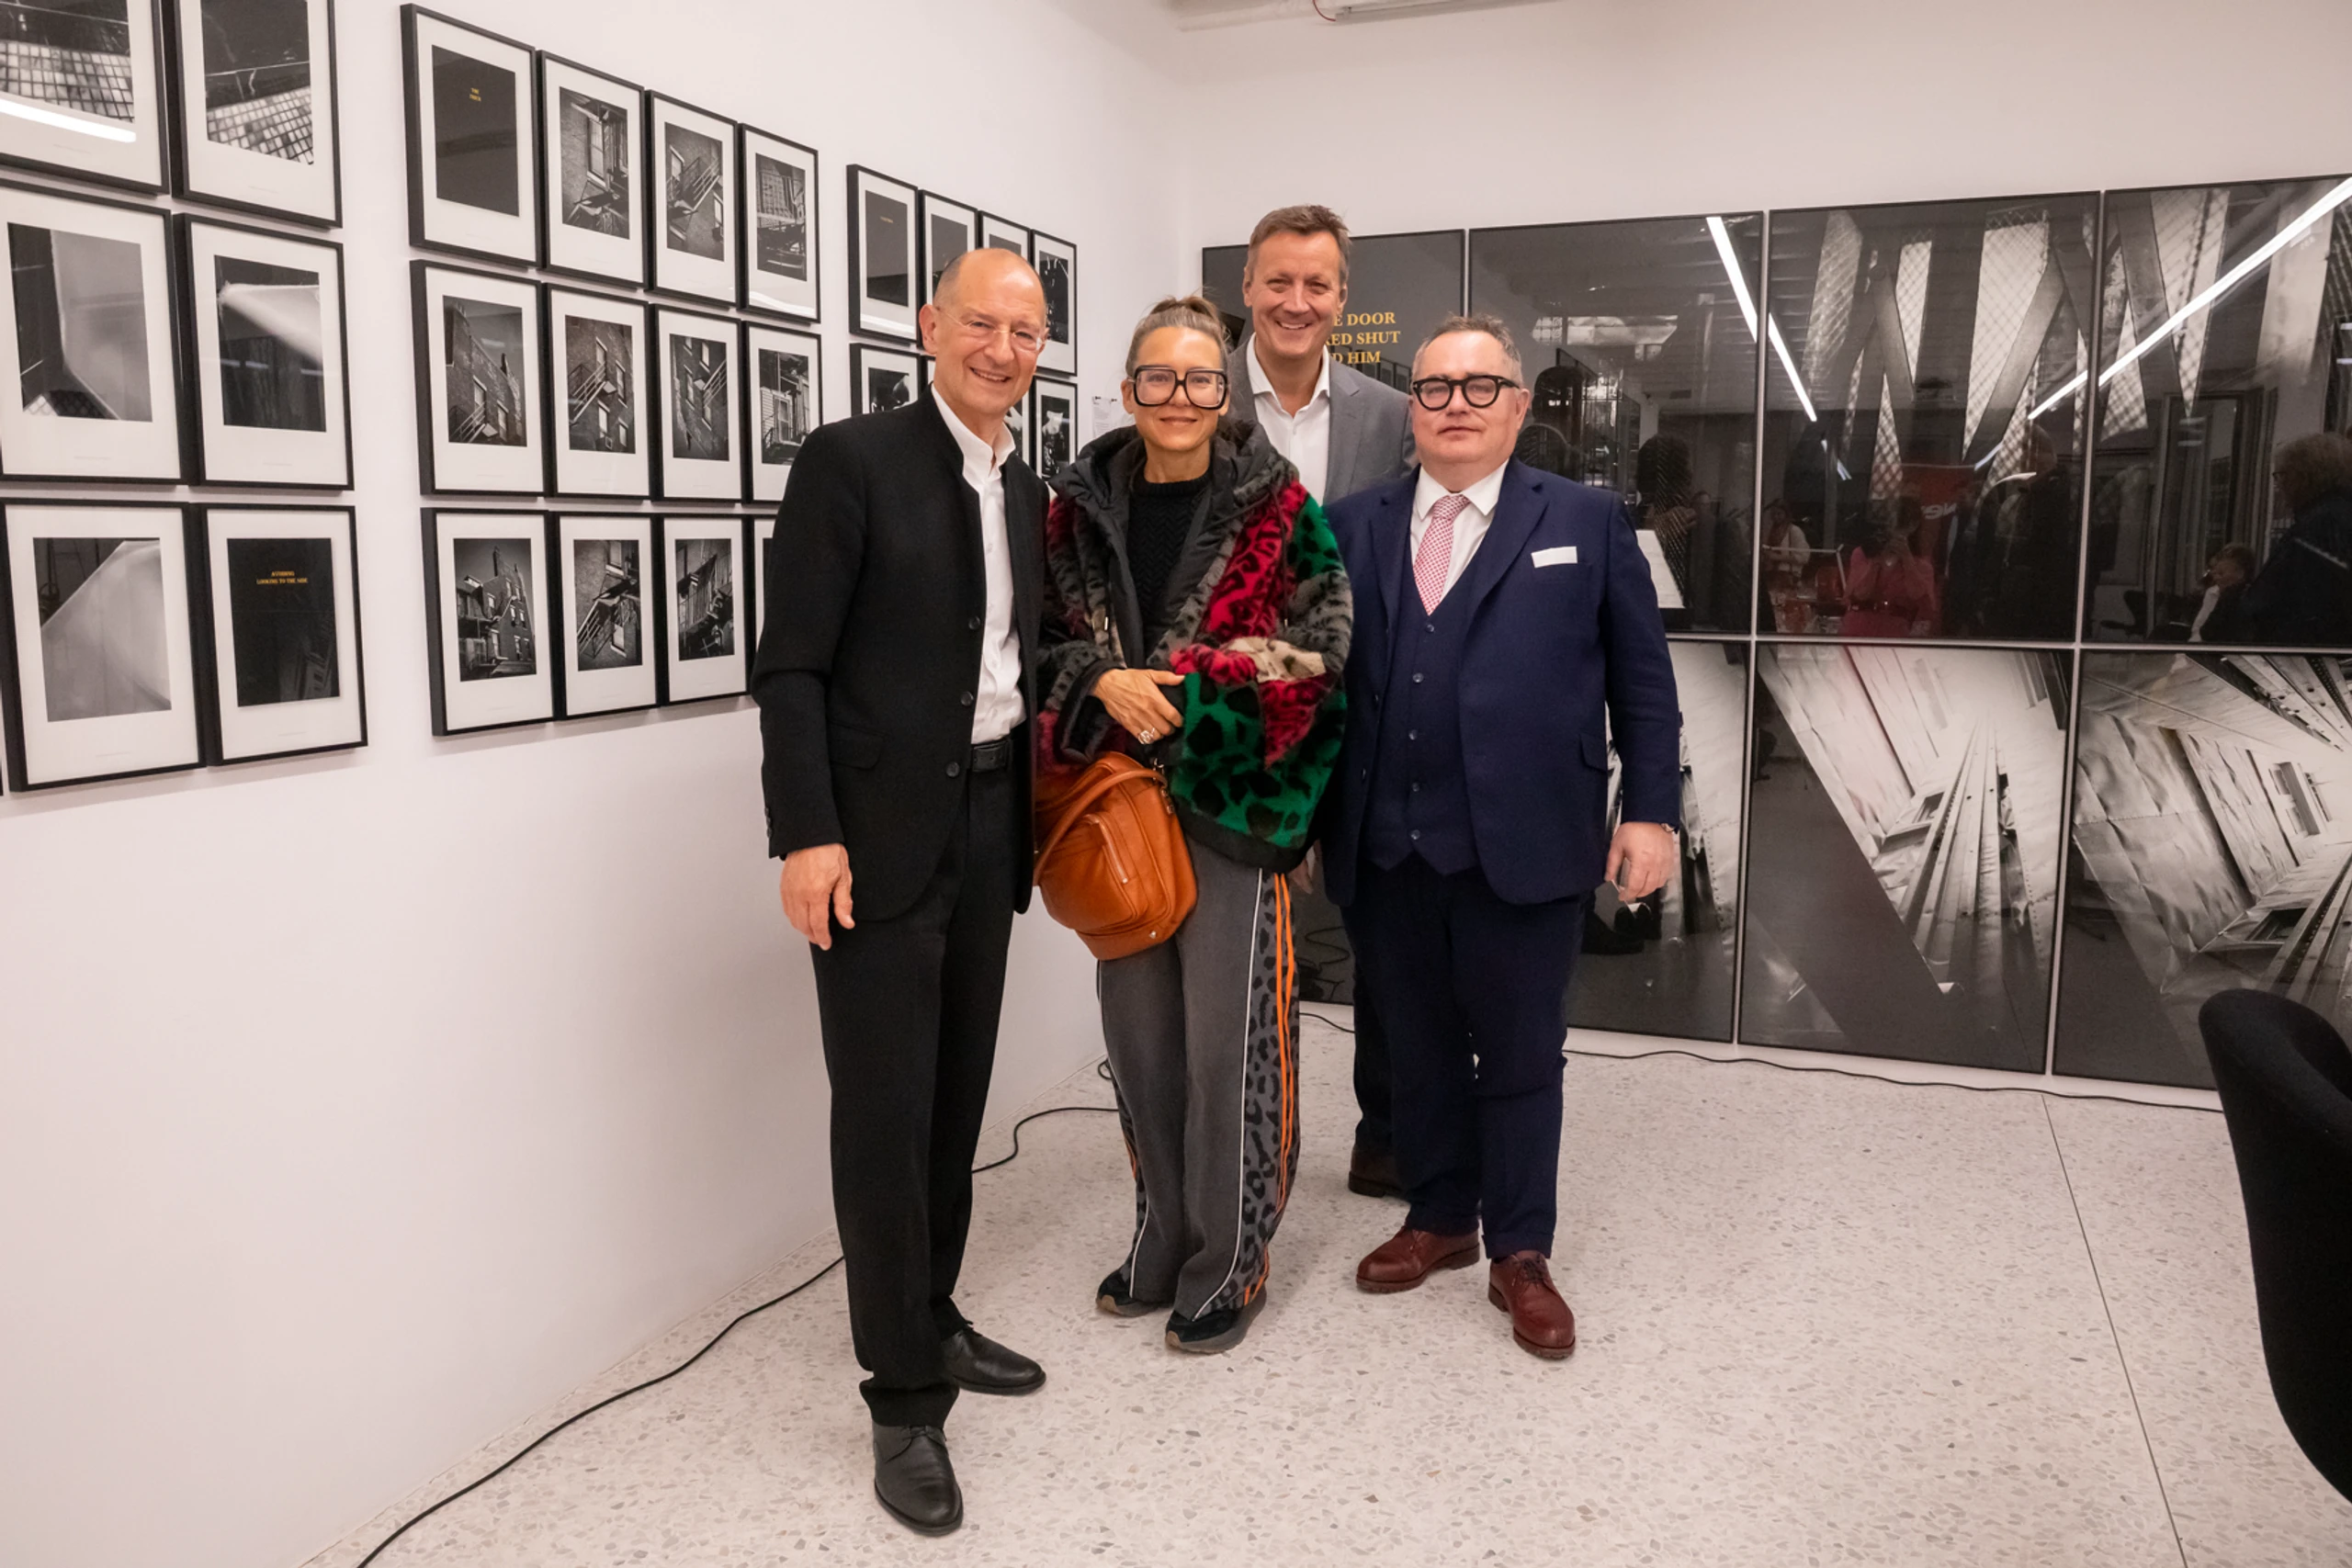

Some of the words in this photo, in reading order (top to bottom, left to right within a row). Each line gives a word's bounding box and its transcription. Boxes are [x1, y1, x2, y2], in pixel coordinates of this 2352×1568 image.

[1347, 311, 1396, 326] DOOR
[1356, 331, 1400, 344] SHUT
[1347, 351, 1381, 364] HIM
